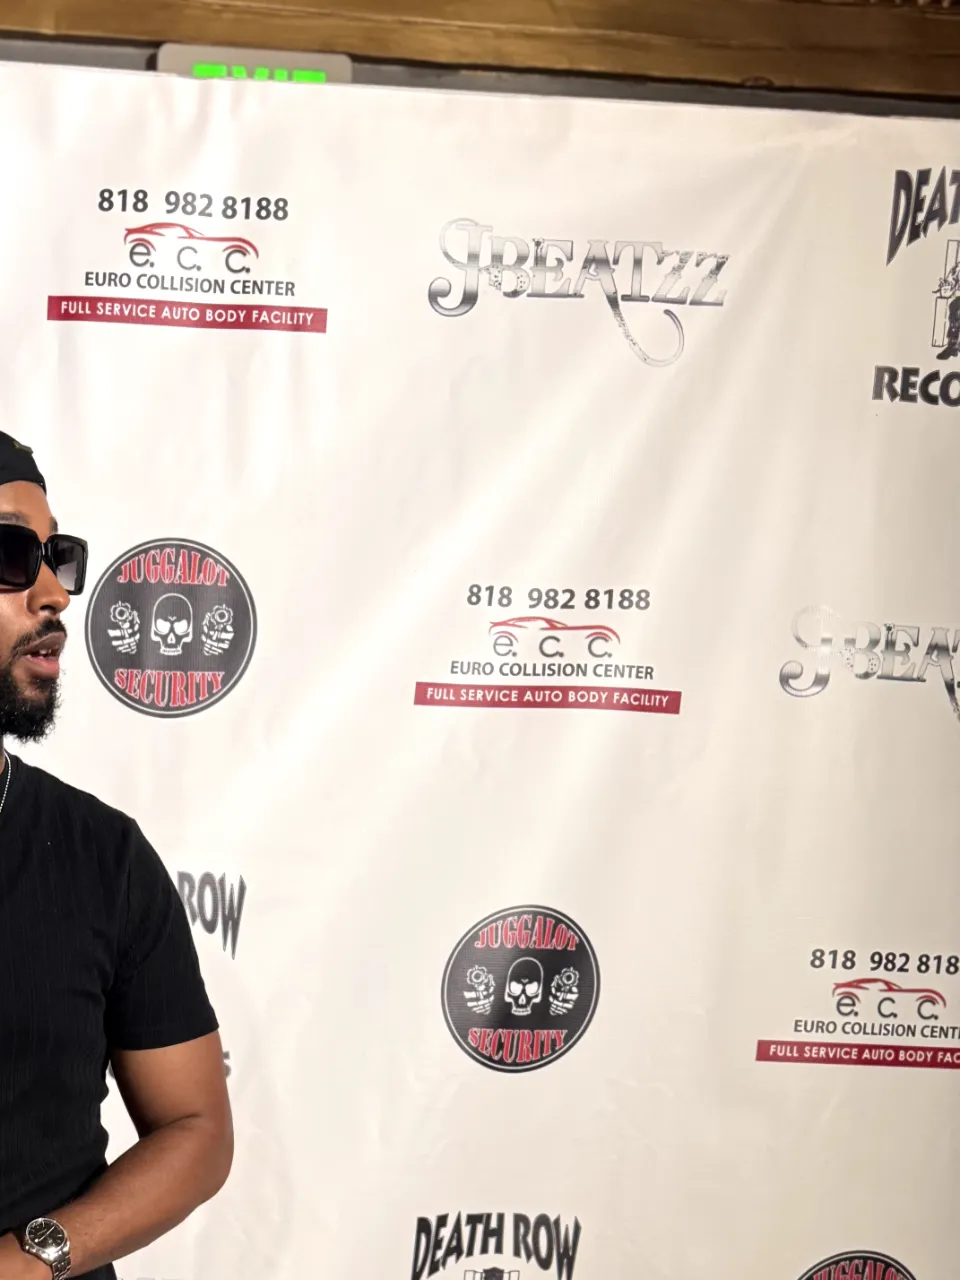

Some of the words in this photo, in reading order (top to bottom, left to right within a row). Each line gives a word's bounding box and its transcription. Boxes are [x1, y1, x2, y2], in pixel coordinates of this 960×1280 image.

[98, 188, 149, 213] 818
[164, 191, 213, 217] 982
[222, 196, 288, 221] 8188
[85, 271, 131, 288] EURO
[137, 274, 225, 294] COLLISION
[230, 279, 295, 296] CENTER
[427, 218, 731, 367] JBEATZZ
[61, 301, 91, 315] FULL
[97, 303, 156, 318] SERVICE
[161, 307, 200, 321] AUTO
[205, 309, 247, 322] BODY
[252, 310, 314, 325] FACILITY
[117, 548, 230, 586] JUGGALOT
[467, 584, 512, 607] 818
[528, 588, 575, 609] 982
[584, 589, 651, 610] 8188
[450, 661, 494, 676] EURO
[499, 663, 588, 677] COLLISION
[592, 664, 654, 680] CENTER
[114, 668, 225, 707] SECURITY
[427, 687, 456, 701] FULL
[460, 689, 518, 702] SERVICE
[523, 690, 562, 702] AUTO
[568, 691, 608, 704] BODY
[613, 692, 669, 707] FACILITY
[474, 914, 579, 950] JUGGALOT
[810, 949, 856, 970] 818
[870, 952, 910, 972] 982
[917, 954, 960, 975] 818
[794, 1020, 837, 1034] EURO
[842, 1022, 917, 1037] COLLISION
[920, 1025, 960, 1039] CENT
[468, 1027, 567, 1063] SECURITY
[770, 1045, 798, 1057] FULL
[804, 1046, 858, 1060] SERVICE
[862, 1049, 895, 1061] AUTO
[899, 1051, 933, 1062] BODY
